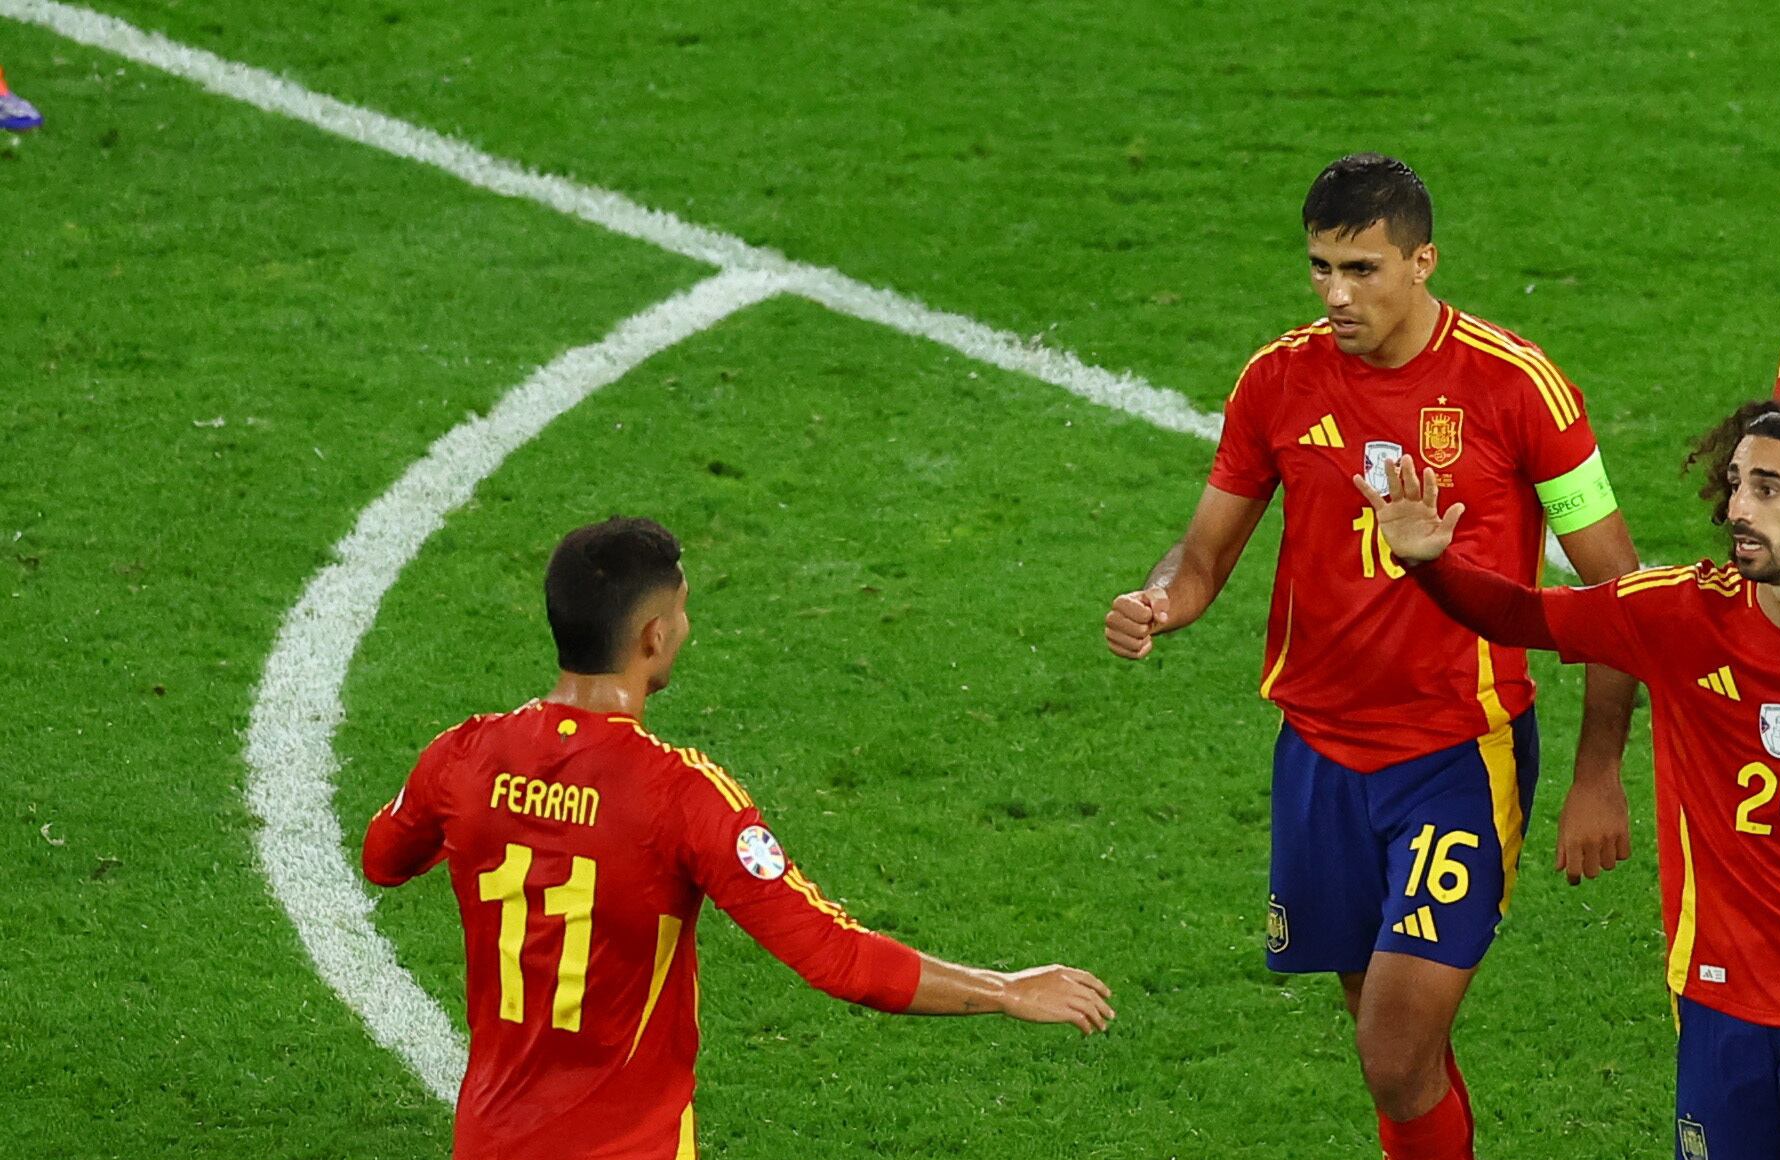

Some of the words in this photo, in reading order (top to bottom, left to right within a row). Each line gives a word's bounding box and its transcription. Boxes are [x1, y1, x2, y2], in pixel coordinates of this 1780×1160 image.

[491, 773, 600, 826] FERRAN
[1405, 824, 1479, 904] 16
[479, 843, 597, 1032] 11
